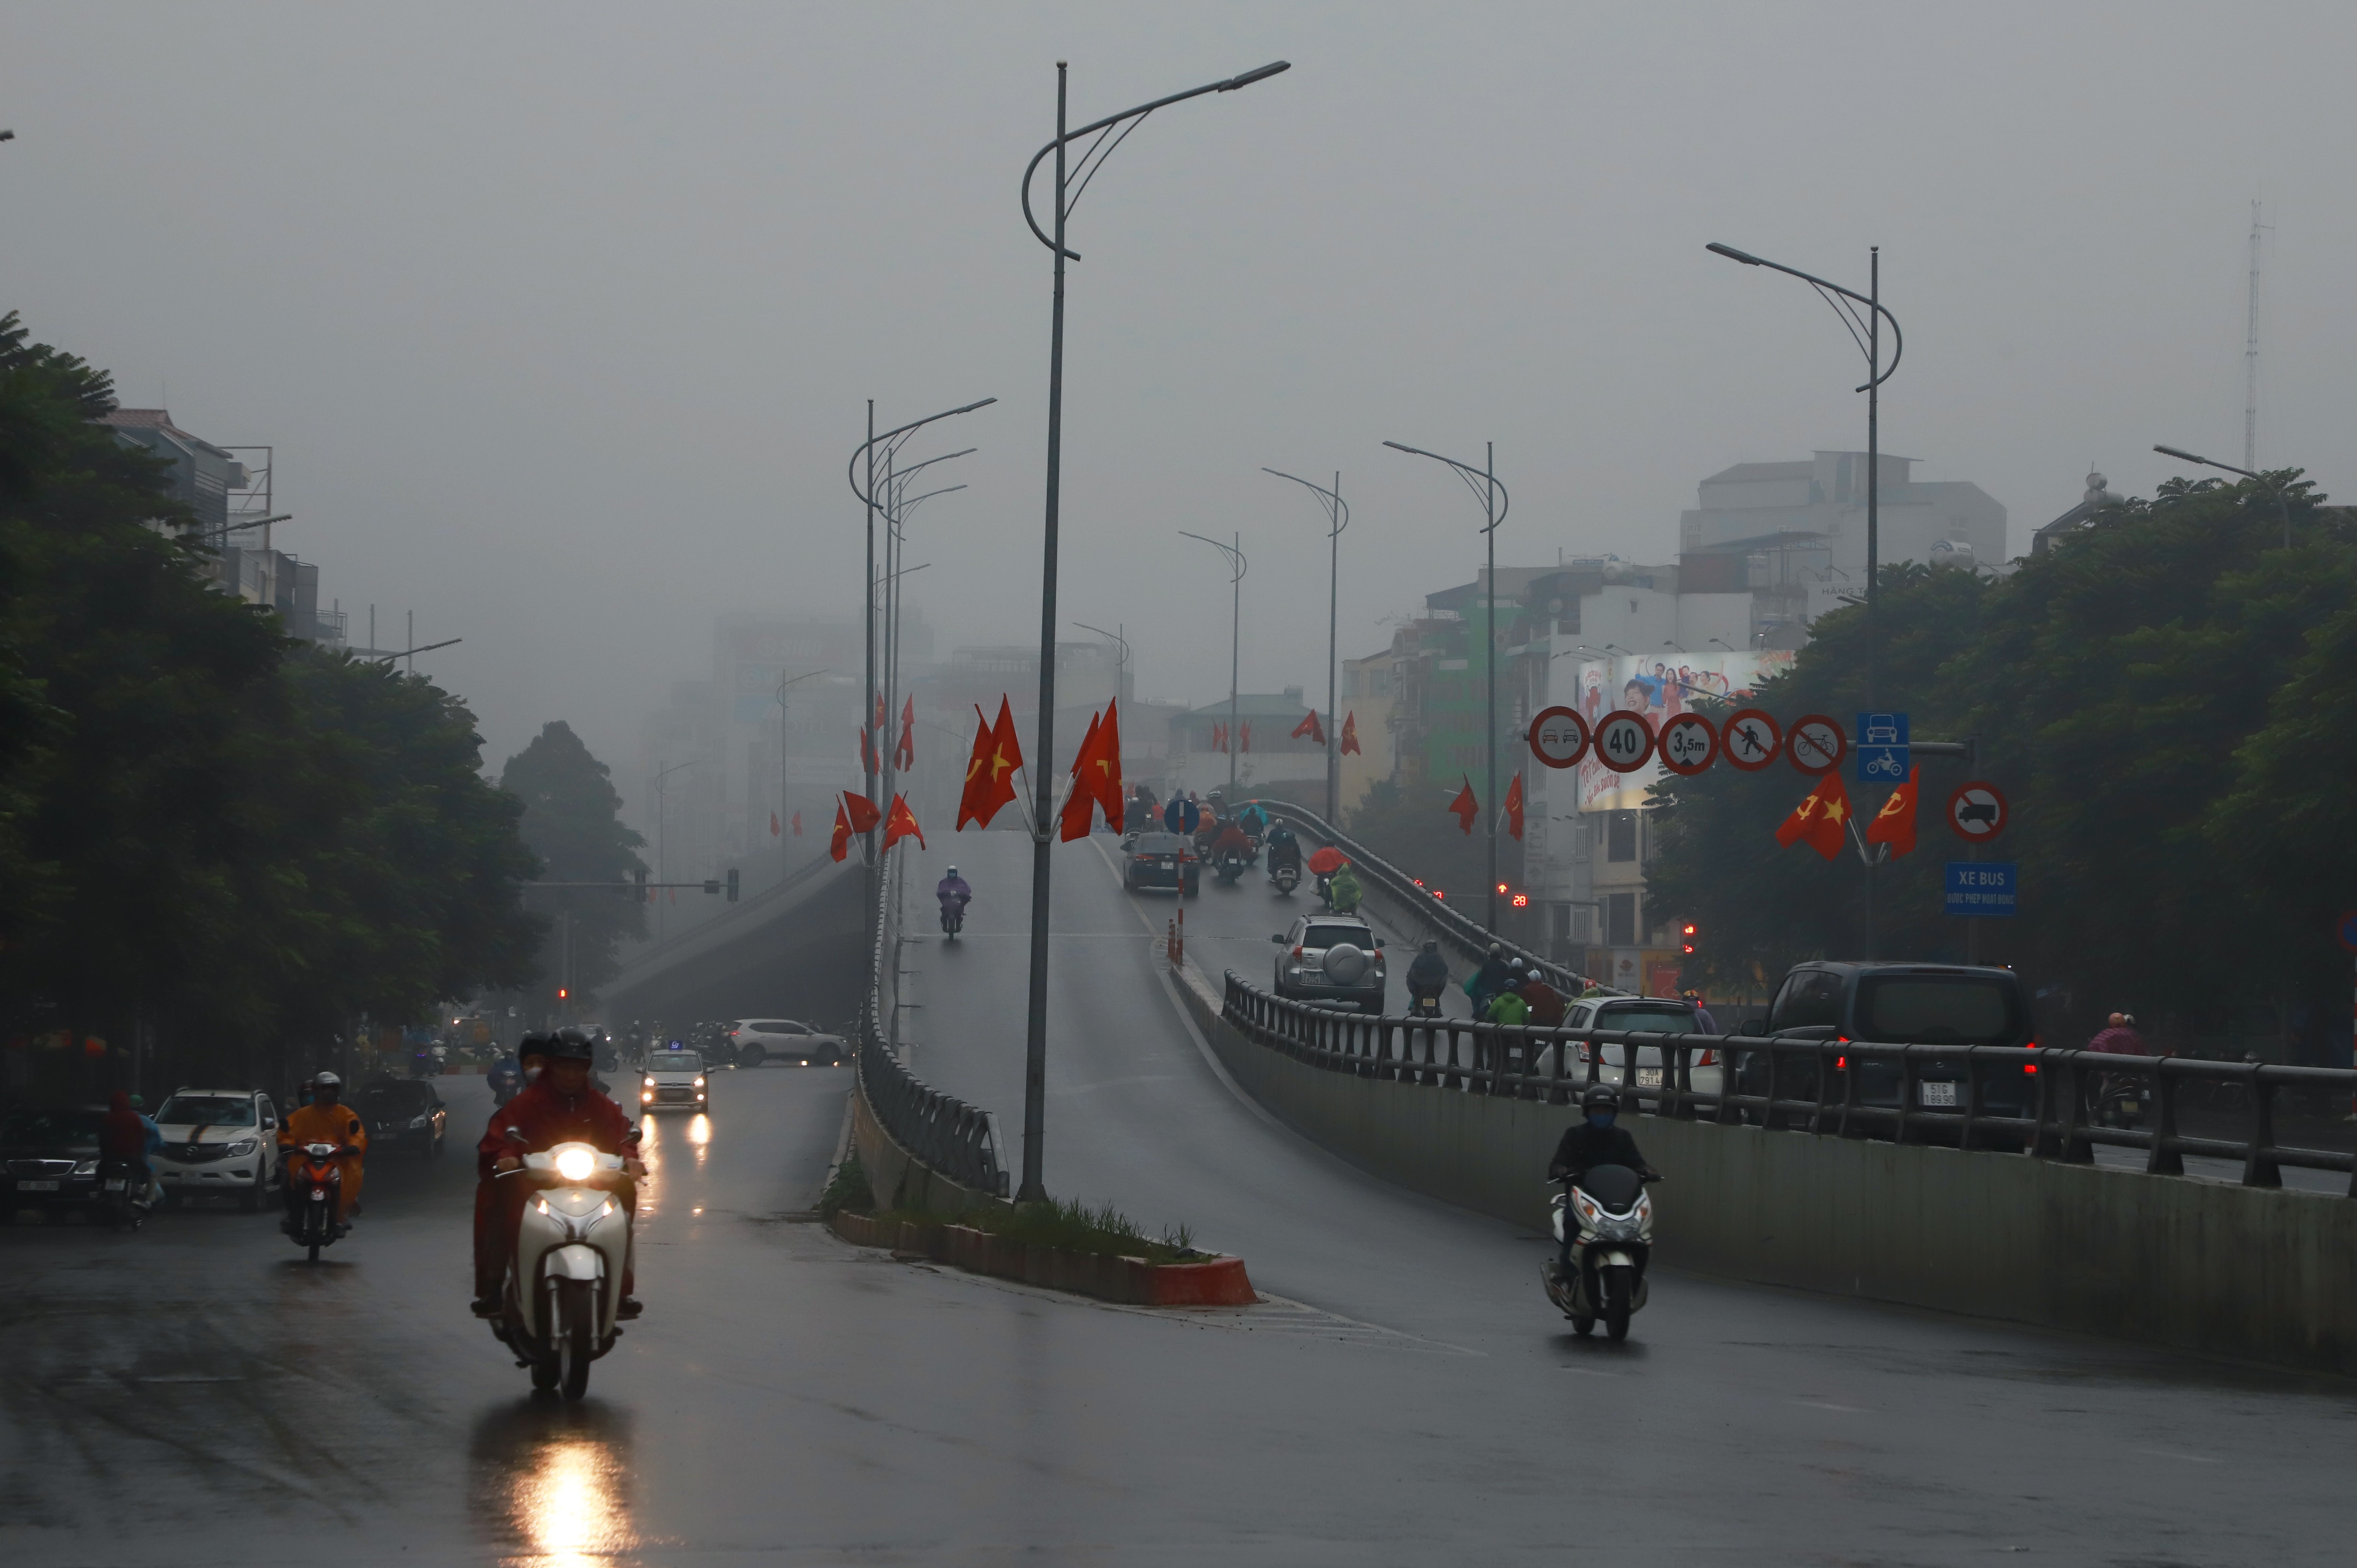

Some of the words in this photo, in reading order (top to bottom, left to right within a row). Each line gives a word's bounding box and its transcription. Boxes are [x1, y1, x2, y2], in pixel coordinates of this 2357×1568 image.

[1610, 728, 1636, 754] 40
[1674, 731, 1705, 757] 3,5m
[1959, 871, 1976, 885] XE
[1980, 872, 2005, 886] BUS
[1513, 896, 1526, 906] 28
[1931, 1084, 1948, 1094] 51G
